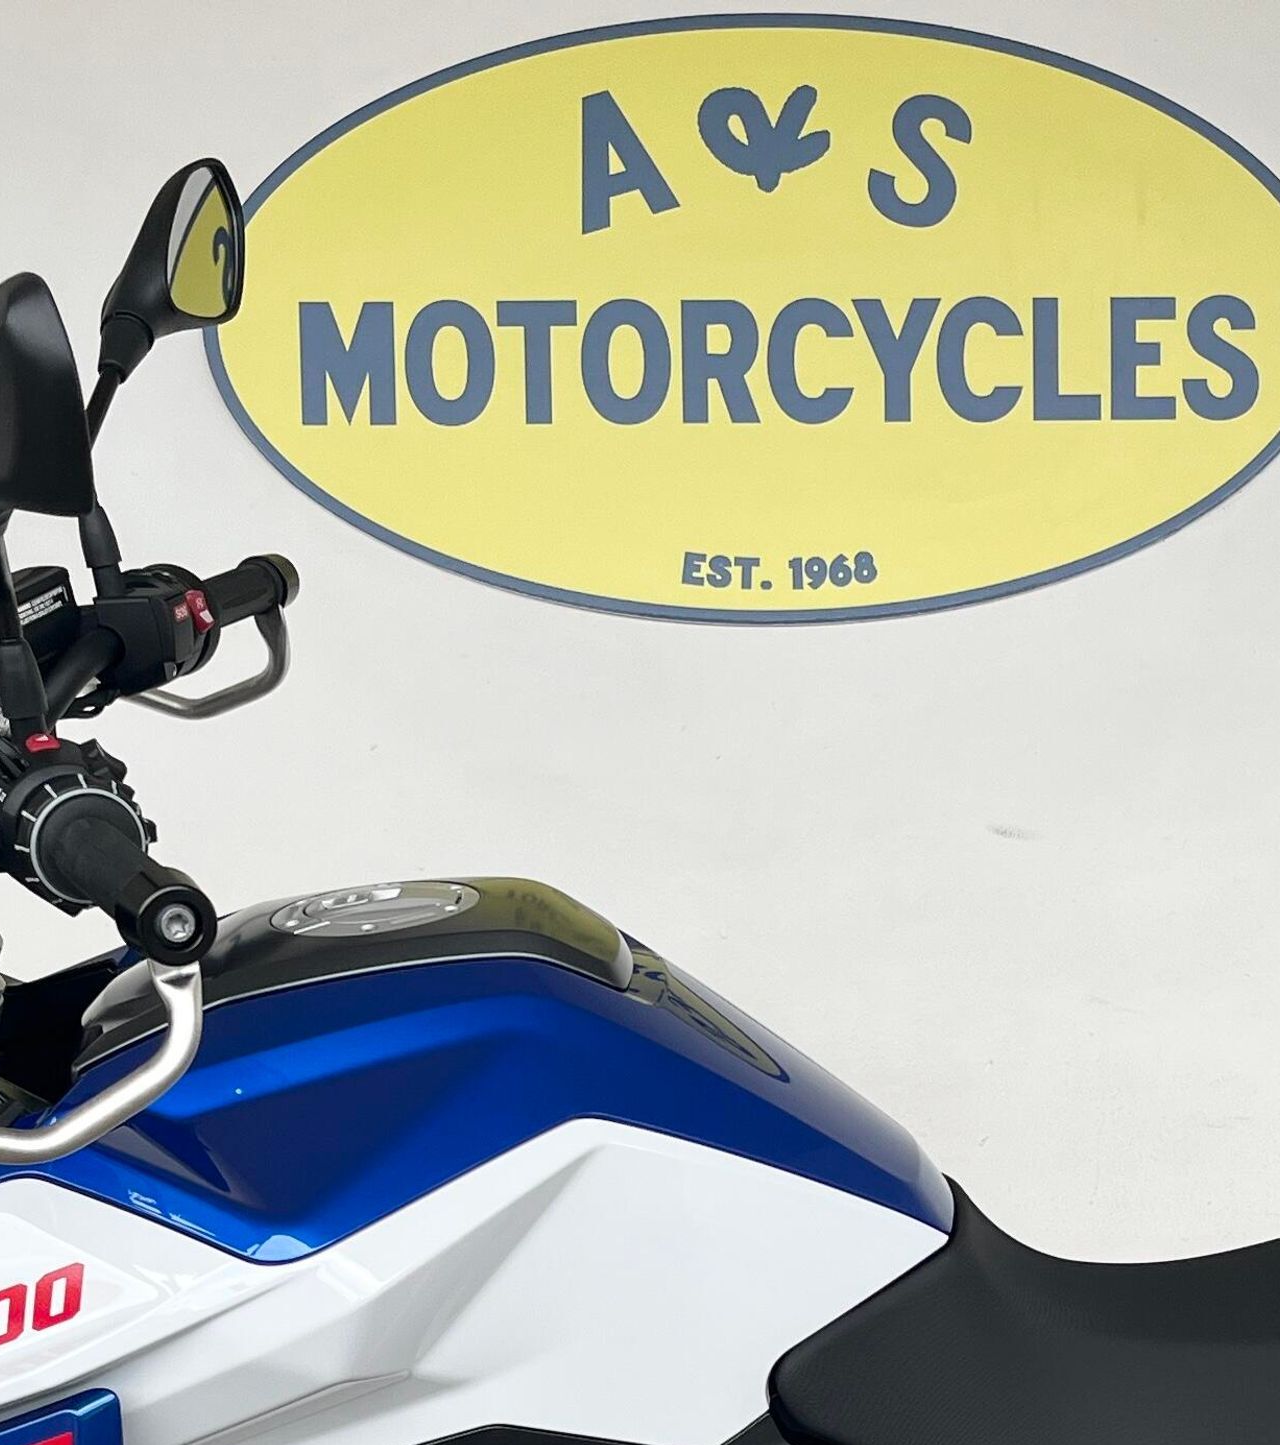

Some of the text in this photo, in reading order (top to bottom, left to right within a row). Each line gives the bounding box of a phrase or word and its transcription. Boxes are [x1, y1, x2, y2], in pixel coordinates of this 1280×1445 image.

[581, 91, 679, 234] A
[867, 94, 973, 228] S
[297, 294, 1260, 427] MOTORCYCLES
[681, 551, 878, 590] EST. 1968
